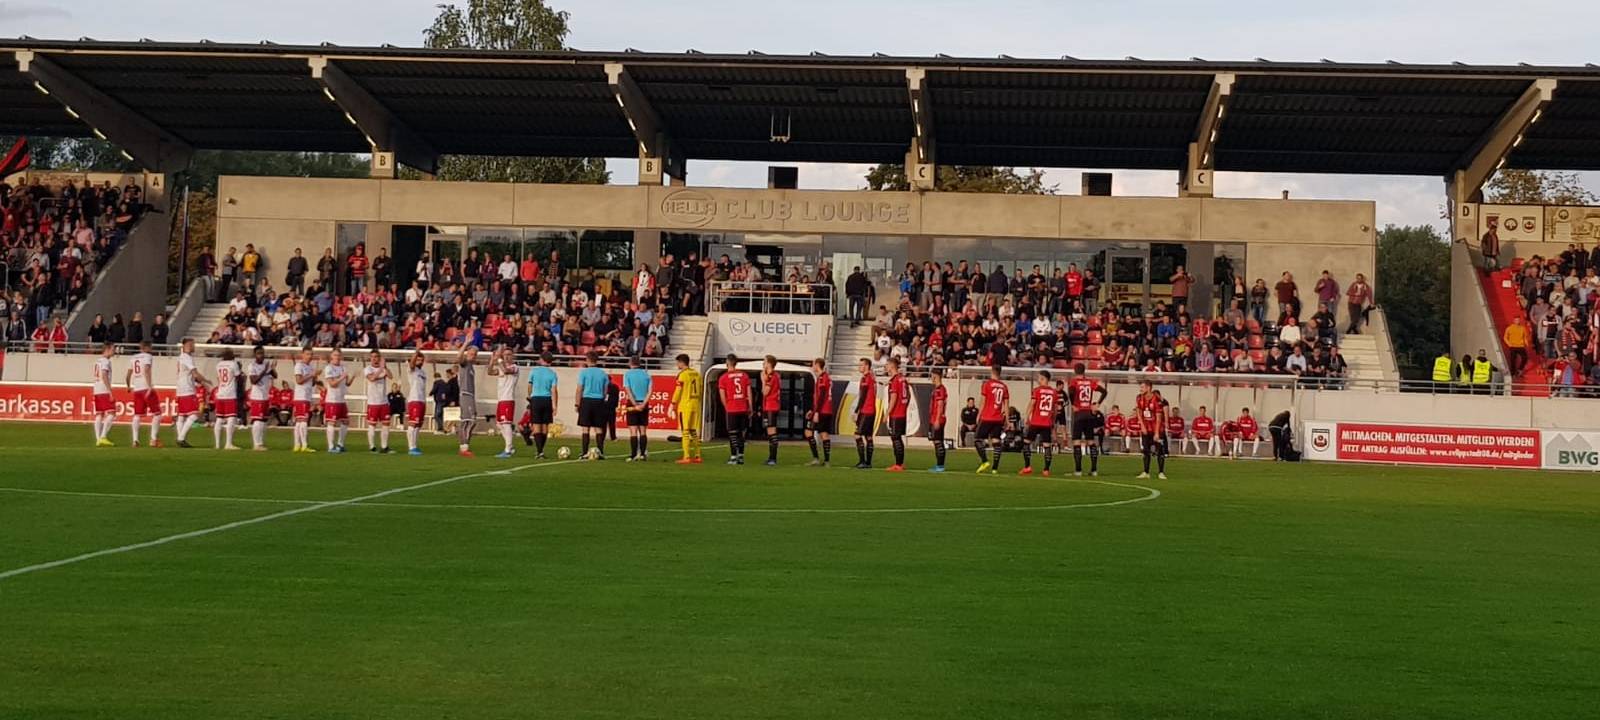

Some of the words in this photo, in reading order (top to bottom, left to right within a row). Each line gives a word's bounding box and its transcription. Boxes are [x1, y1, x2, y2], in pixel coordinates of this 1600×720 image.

[379, 155, 386, 166] B
[645, 160, 653, 173] B
[918, 165, 927, 178] C
[1197, 172, 1205, 184] C
[152, 176, 160, 187] A
[663, 201, 717, 216] HELLA
[725, 199, 793, 221] CLUB
[801, 200, 910, 224] LOUNGE
[1462, 205, 1470, 217] D
[753, 321, 812, 335] LIEBELT
[133, 359, 141, 374] 6
[218, 368, 229, 383] 18
[691, 378, 697, 394] 1
[733, 377, 742, 394] 5
[1079, 385, 1092, 401] 29
[991, 387, 1004, 405] 10
[1039, 394, 1053, 411] 23
[1341, 430, 1394, 442] MITMACHEN.
[1395, 432, 1455, 445] MITGESTALTEN.
[1456, 434, 1495, 446] MITGLIED
[1496, 436, 1535, 447] WERDEN!
[1341, 444, 1359, 453] JETZT
[1361, 445, 1388, 454] ANTRAG
[1558, 450, 1599, 466] BWG
